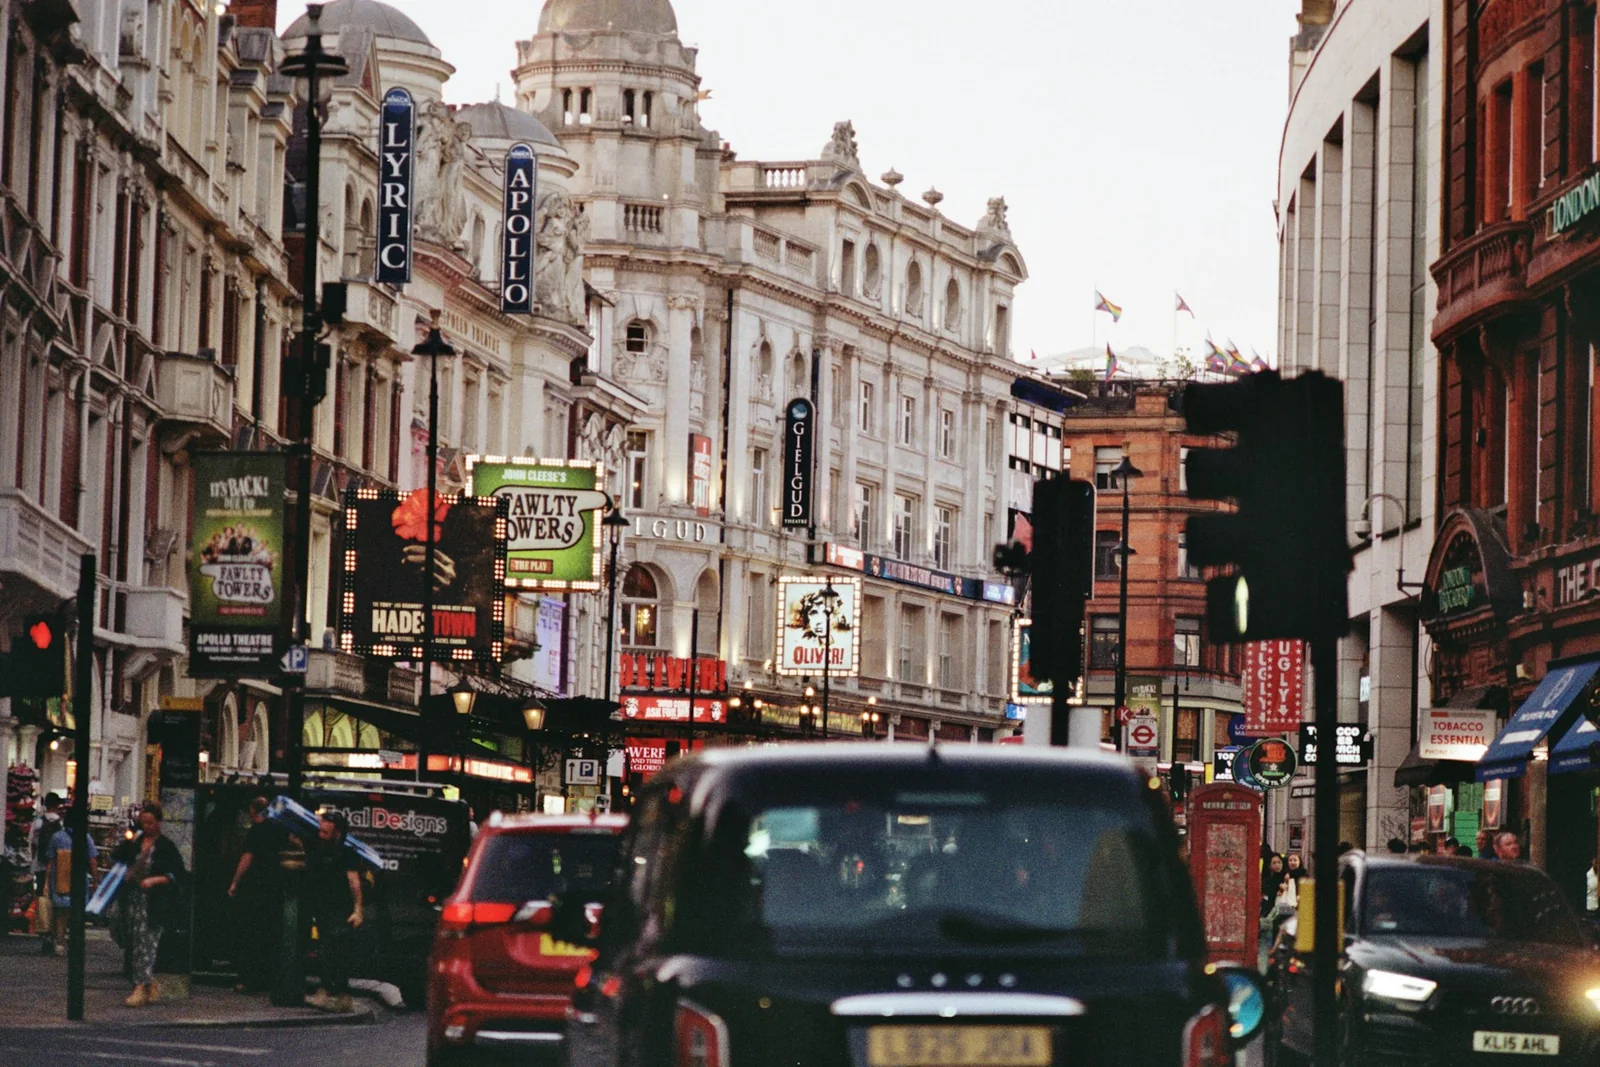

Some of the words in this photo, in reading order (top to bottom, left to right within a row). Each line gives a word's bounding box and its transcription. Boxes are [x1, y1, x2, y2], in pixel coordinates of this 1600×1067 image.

[381, 122, 407, 269] LYRIC
[1553, 172, 1600, 233] LONDON
[505, 168, 530, 304] APOLLO
[502, 469, 526, 480] JOHN
[527, 471, 567, 482] CLEESE'S
[790, 422, 805, 517] GIELGUD
[228, 475, 268, 497] BACK!
[502, 493, 577, 516] FAWLTY
[506, 517, 574, 543] OWERS
[220, 566, 264, 580] FAWLTY
[514, 561, 529, 570] THE
[530, 561, 547, 571] PLAY
[217, 580, 271, 600] TOWERS
[1558, 563, 1586, 603] THE
[432, 611, 476, 637] TOWN
[196, 634, 231, 645] APOLLO
[232, 634, 273, 646] THEATRE
[292, 649, 304, 669] P
[793, 646, 845, 665] OLIVR!
[1278, 641, 1290, 706] UGLY
[1120, 709, 1129, 720] K
[1307, 726, 1360, 737] TCCO
[1433, 721, 1483, 731] TOBACCO
[1430, 735, 1487, 745] ESSENTIAL
[582, 763, 591, 776] P
[1255, 773, 1270, 785] OPEN
[371, 807, 447, 836] Designs
[1522, 1037, 1551, 1052] AHL
